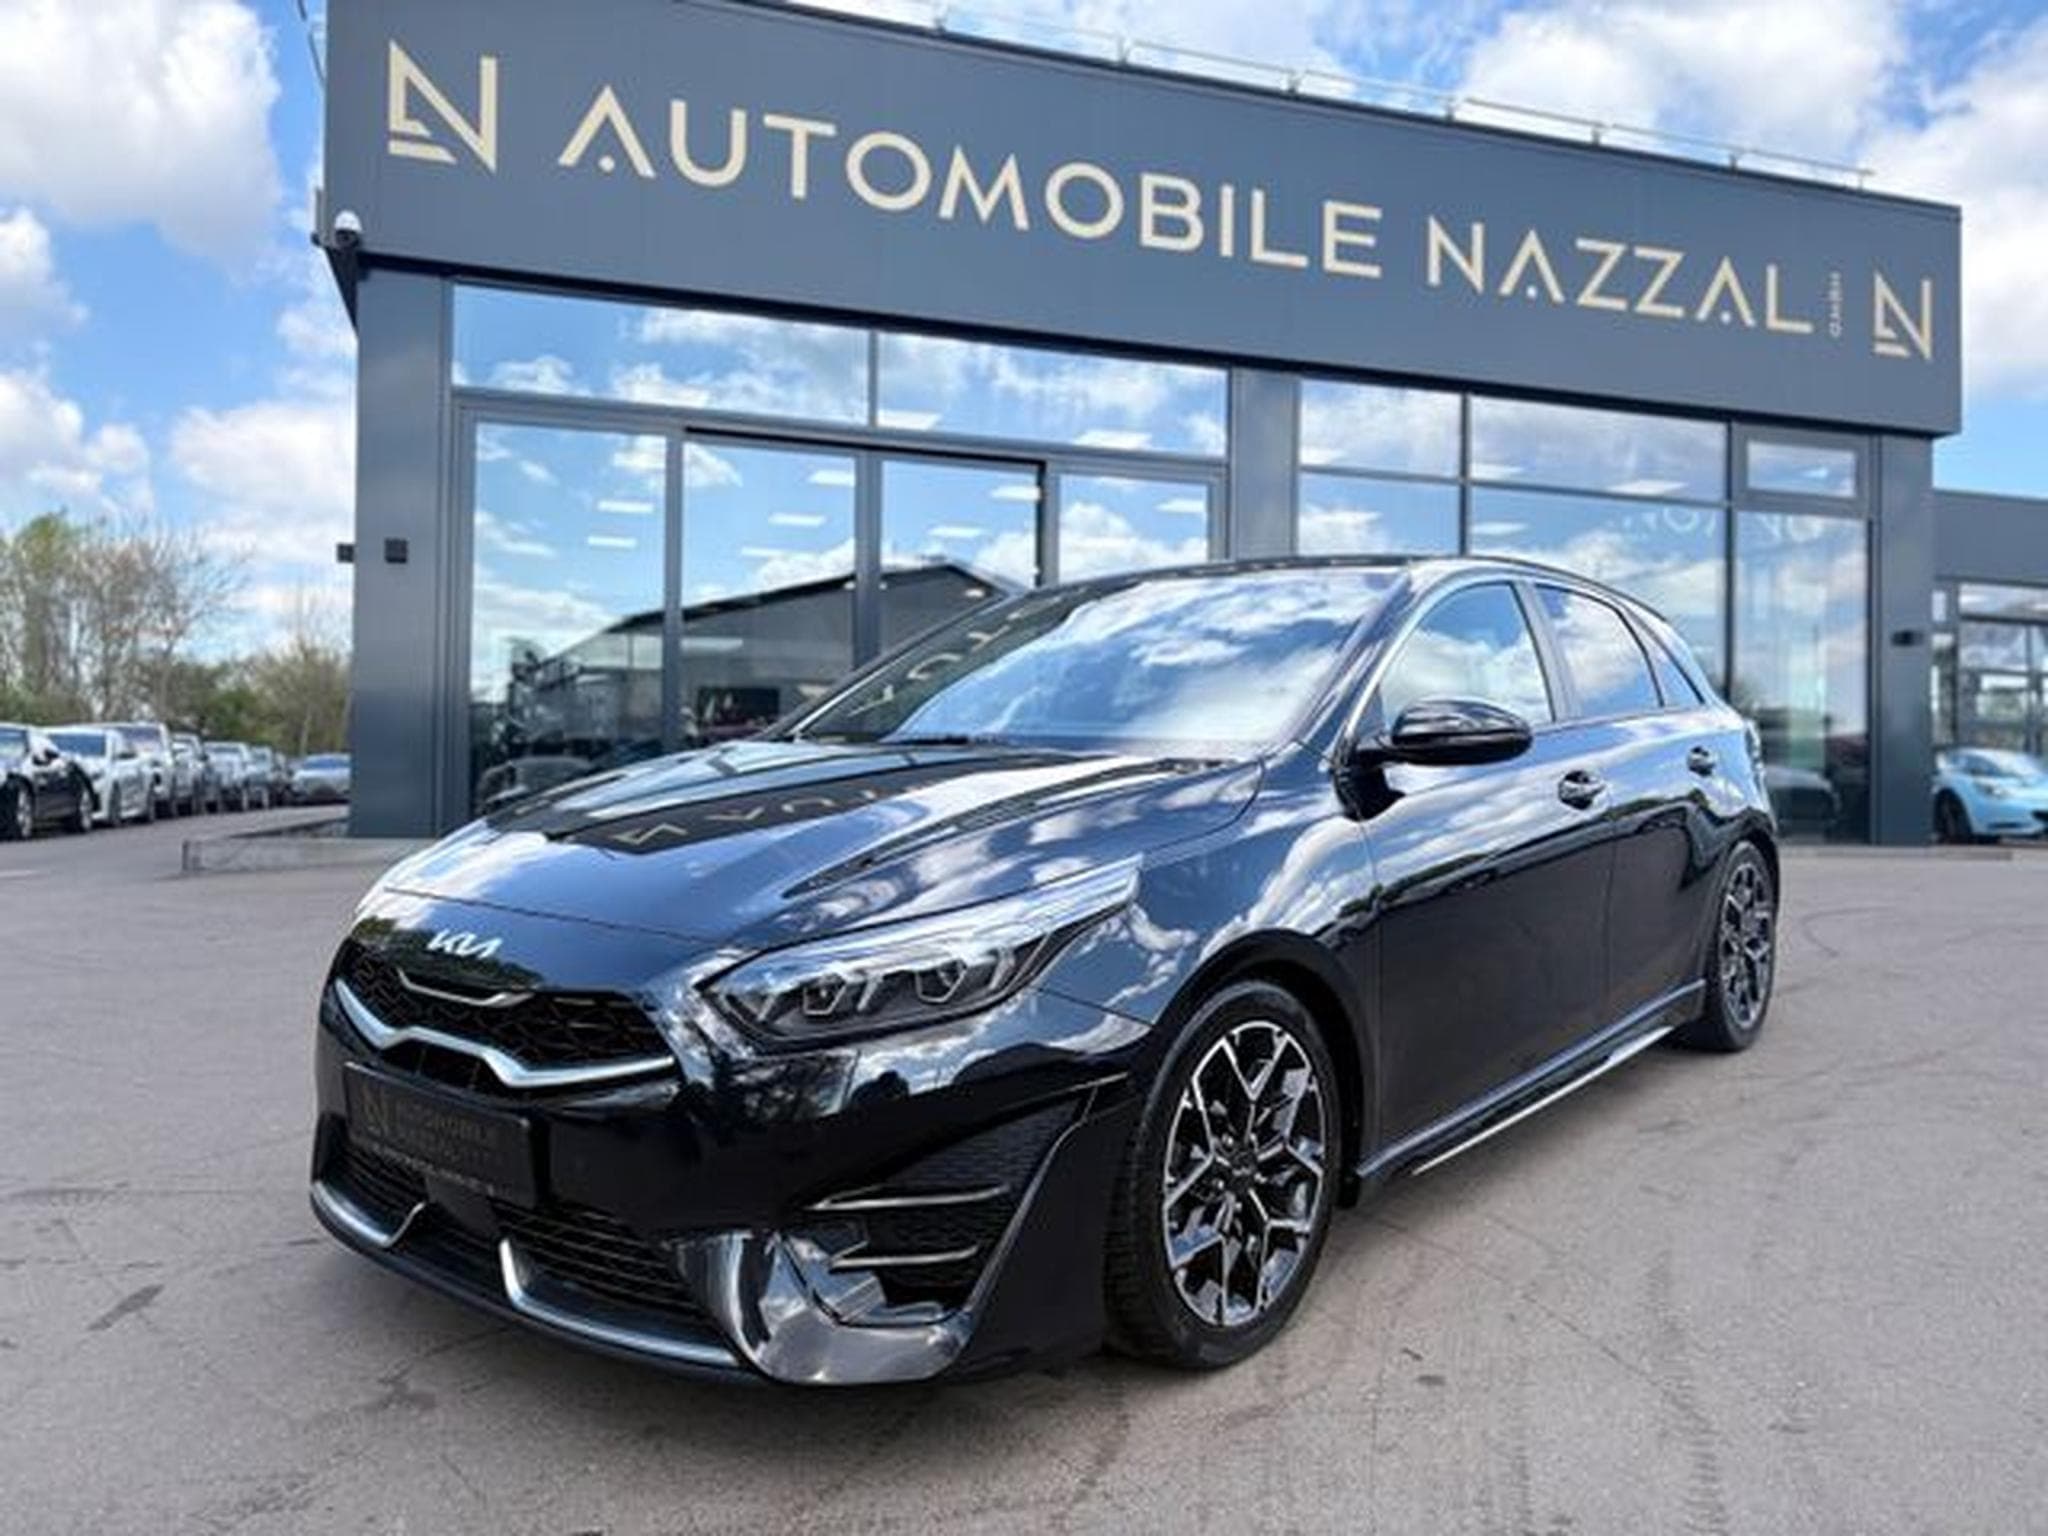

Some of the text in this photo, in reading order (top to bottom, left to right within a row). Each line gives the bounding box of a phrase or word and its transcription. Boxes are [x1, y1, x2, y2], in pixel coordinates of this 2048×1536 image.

[558, 85, 1383, 281] AUTOMOBILE
[1427, 216, 1813, 334] NAZZAL
[427, 929, 502, 958] KIA
